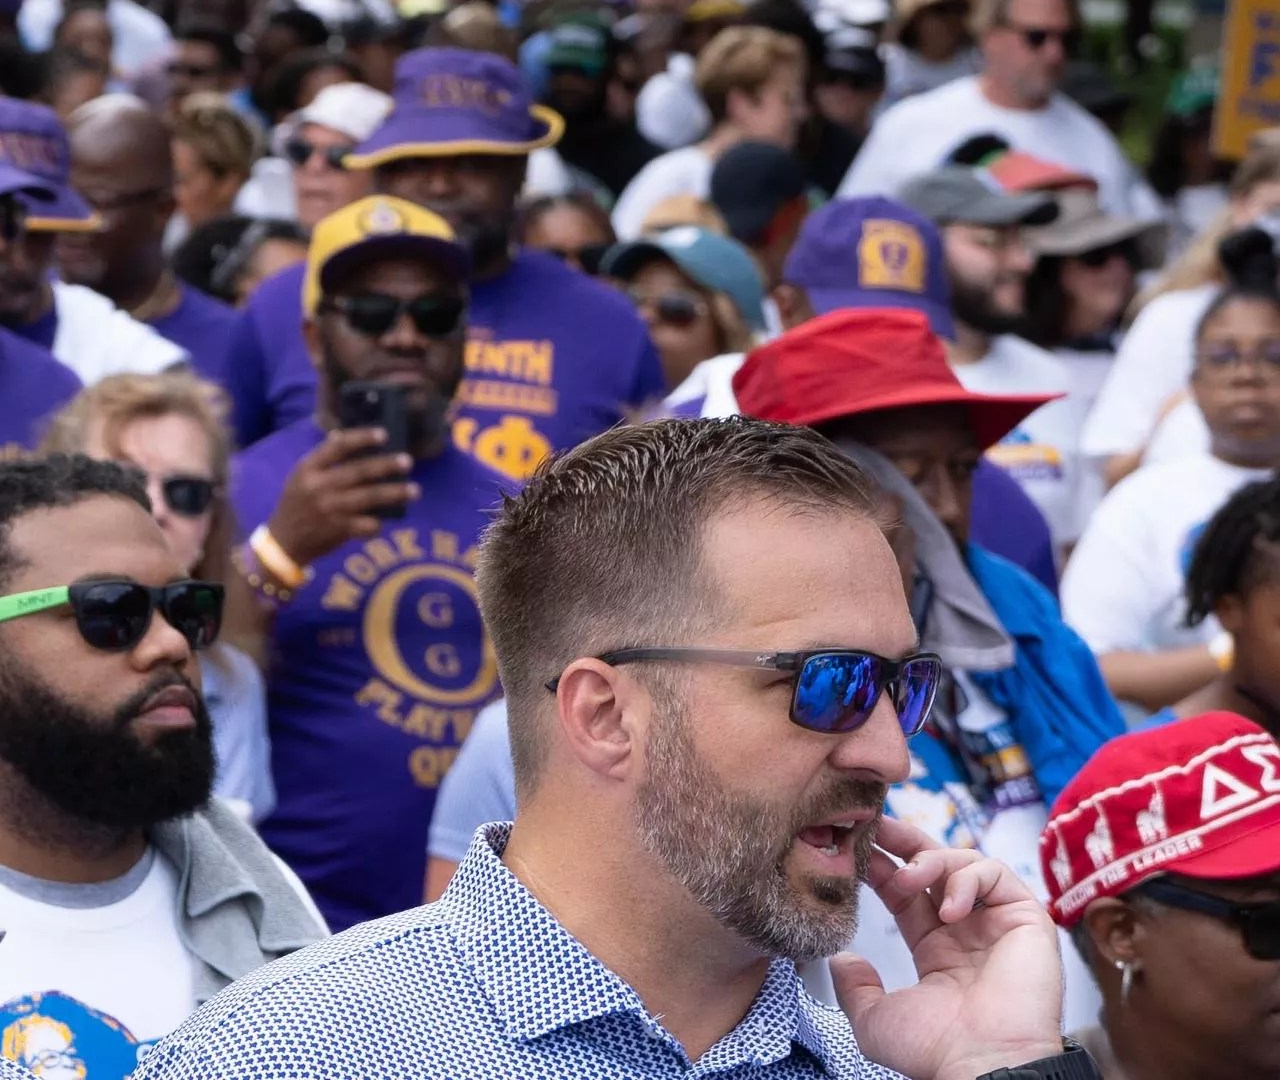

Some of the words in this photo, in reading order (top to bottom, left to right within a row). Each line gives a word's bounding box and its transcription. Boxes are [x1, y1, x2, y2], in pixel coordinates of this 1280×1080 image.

[321, 528, 424, 610] WORK
[1100, 862, 1130, 889] THE
[1132, 834, 1203, 872] LEADER
